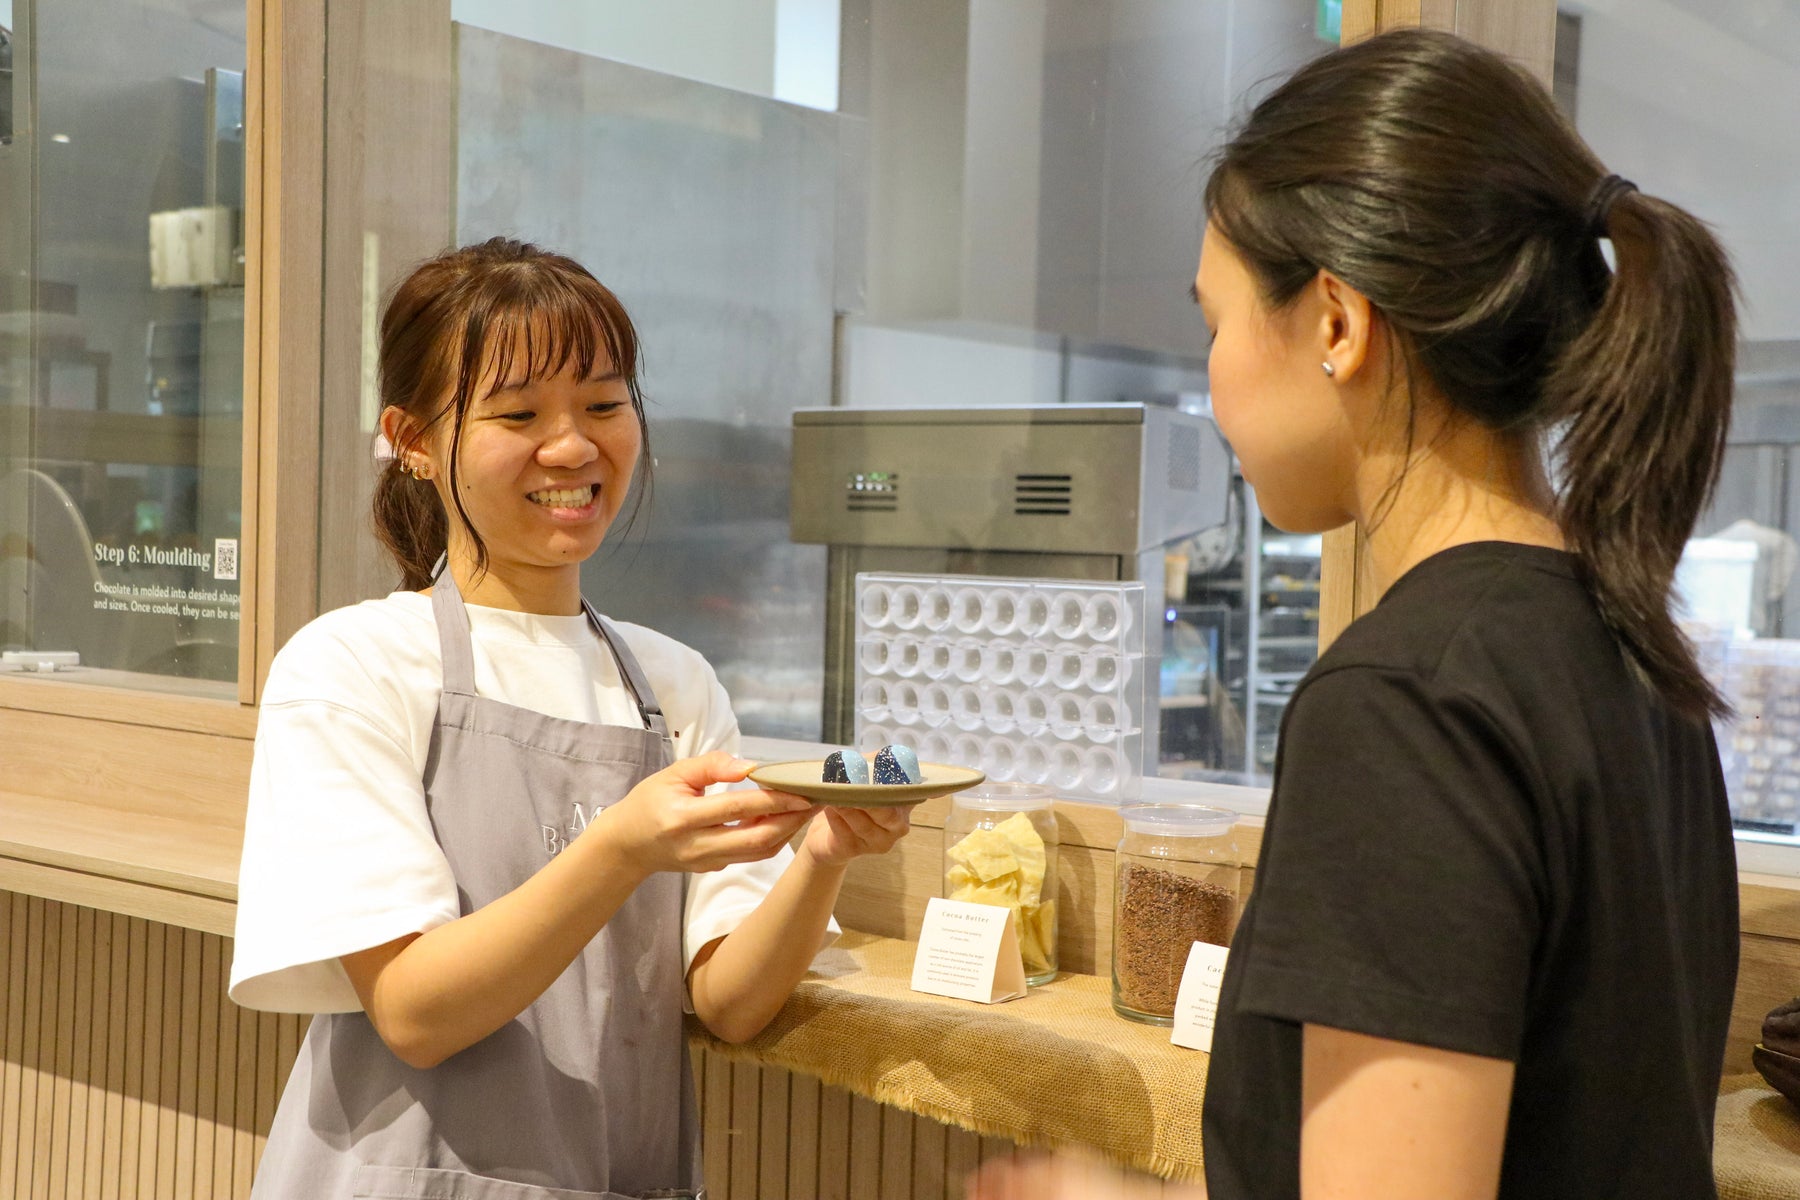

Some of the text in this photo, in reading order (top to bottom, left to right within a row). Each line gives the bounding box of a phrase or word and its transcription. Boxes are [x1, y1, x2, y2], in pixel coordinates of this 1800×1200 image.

[94, 543, 211, 572] Step 6: Moulding
[94, 582, 131, 595] Chocolate
[132, 584, 139, 595] is
[140, 585, 169, 598] molded
[171, 586, 187, 599] into
[188, 588, 218, 602] desired
[94, 599, 240, 620] and sizes. Once cooled, they can be se
